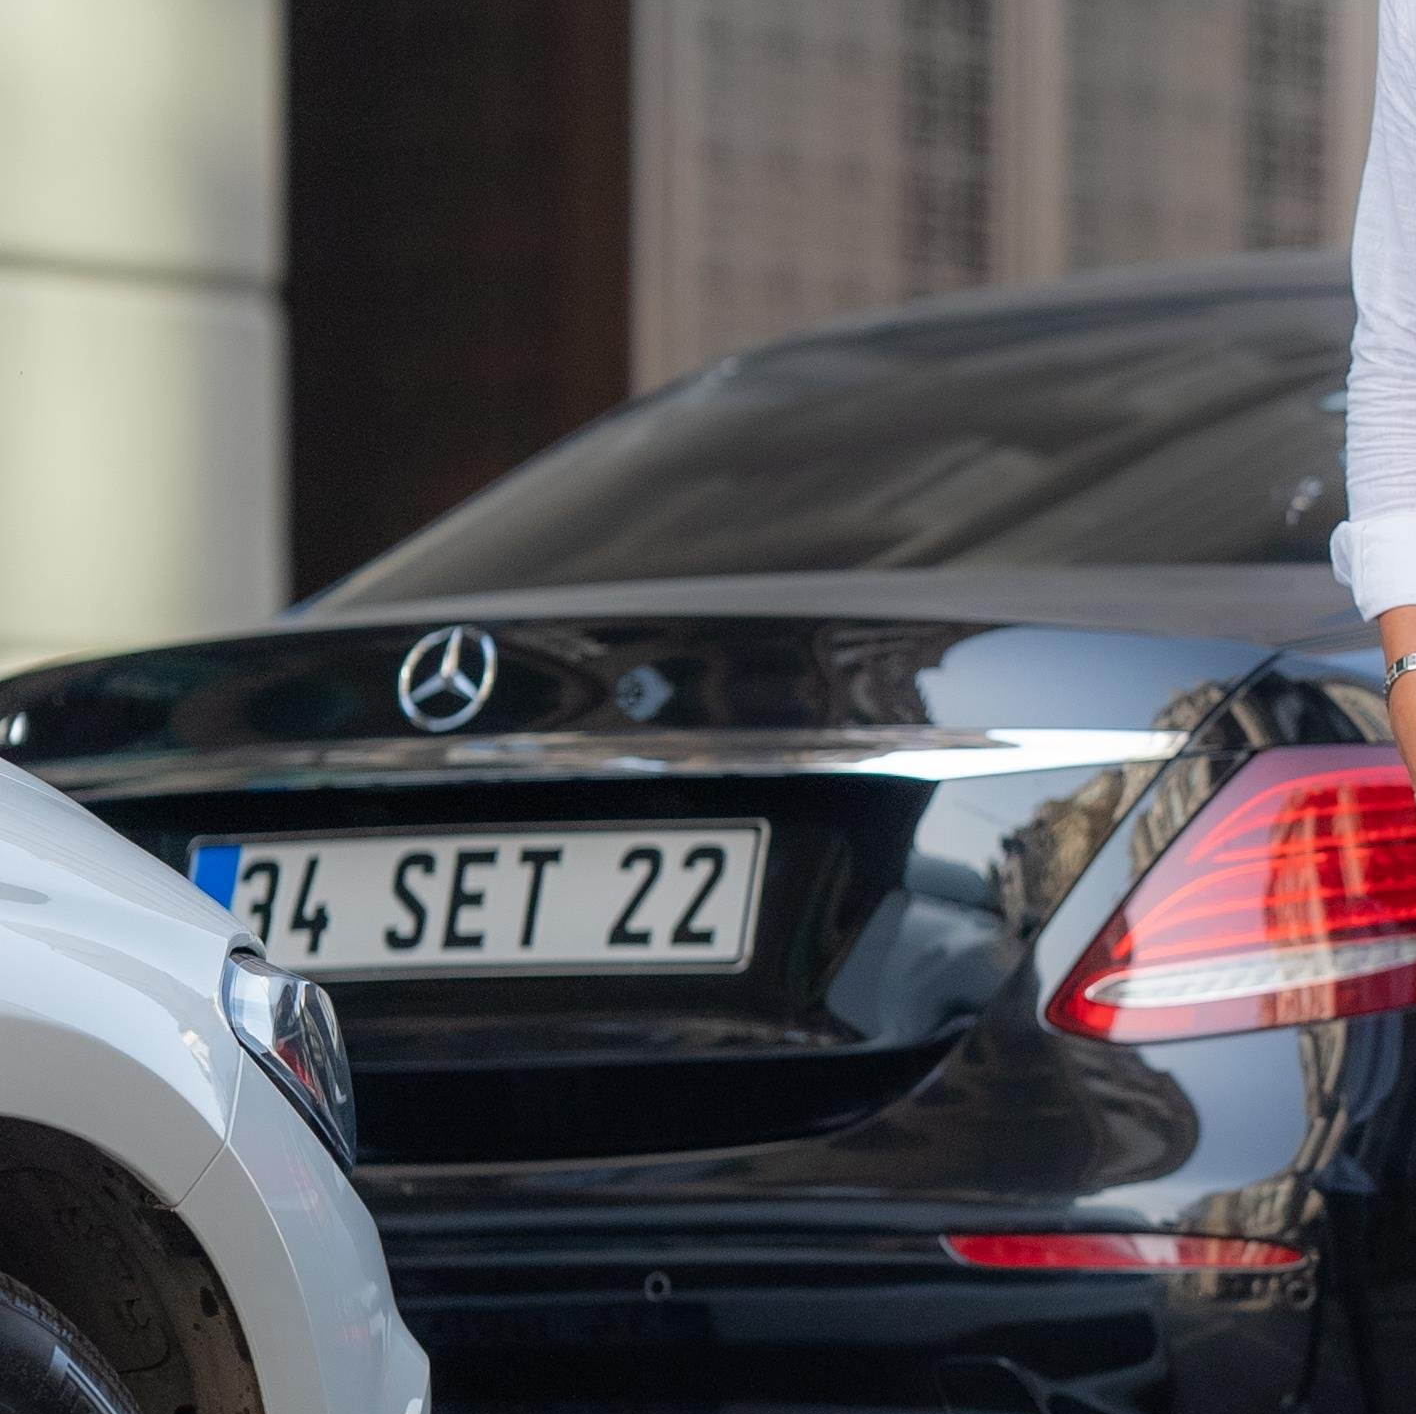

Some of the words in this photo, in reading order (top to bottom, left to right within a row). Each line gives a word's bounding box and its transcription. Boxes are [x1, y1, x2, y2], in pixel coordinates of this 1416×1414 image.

[242, 855, 329, 954] 34
[384, 847, 564, 951] SET
[607, 845, 728, 947] 22
